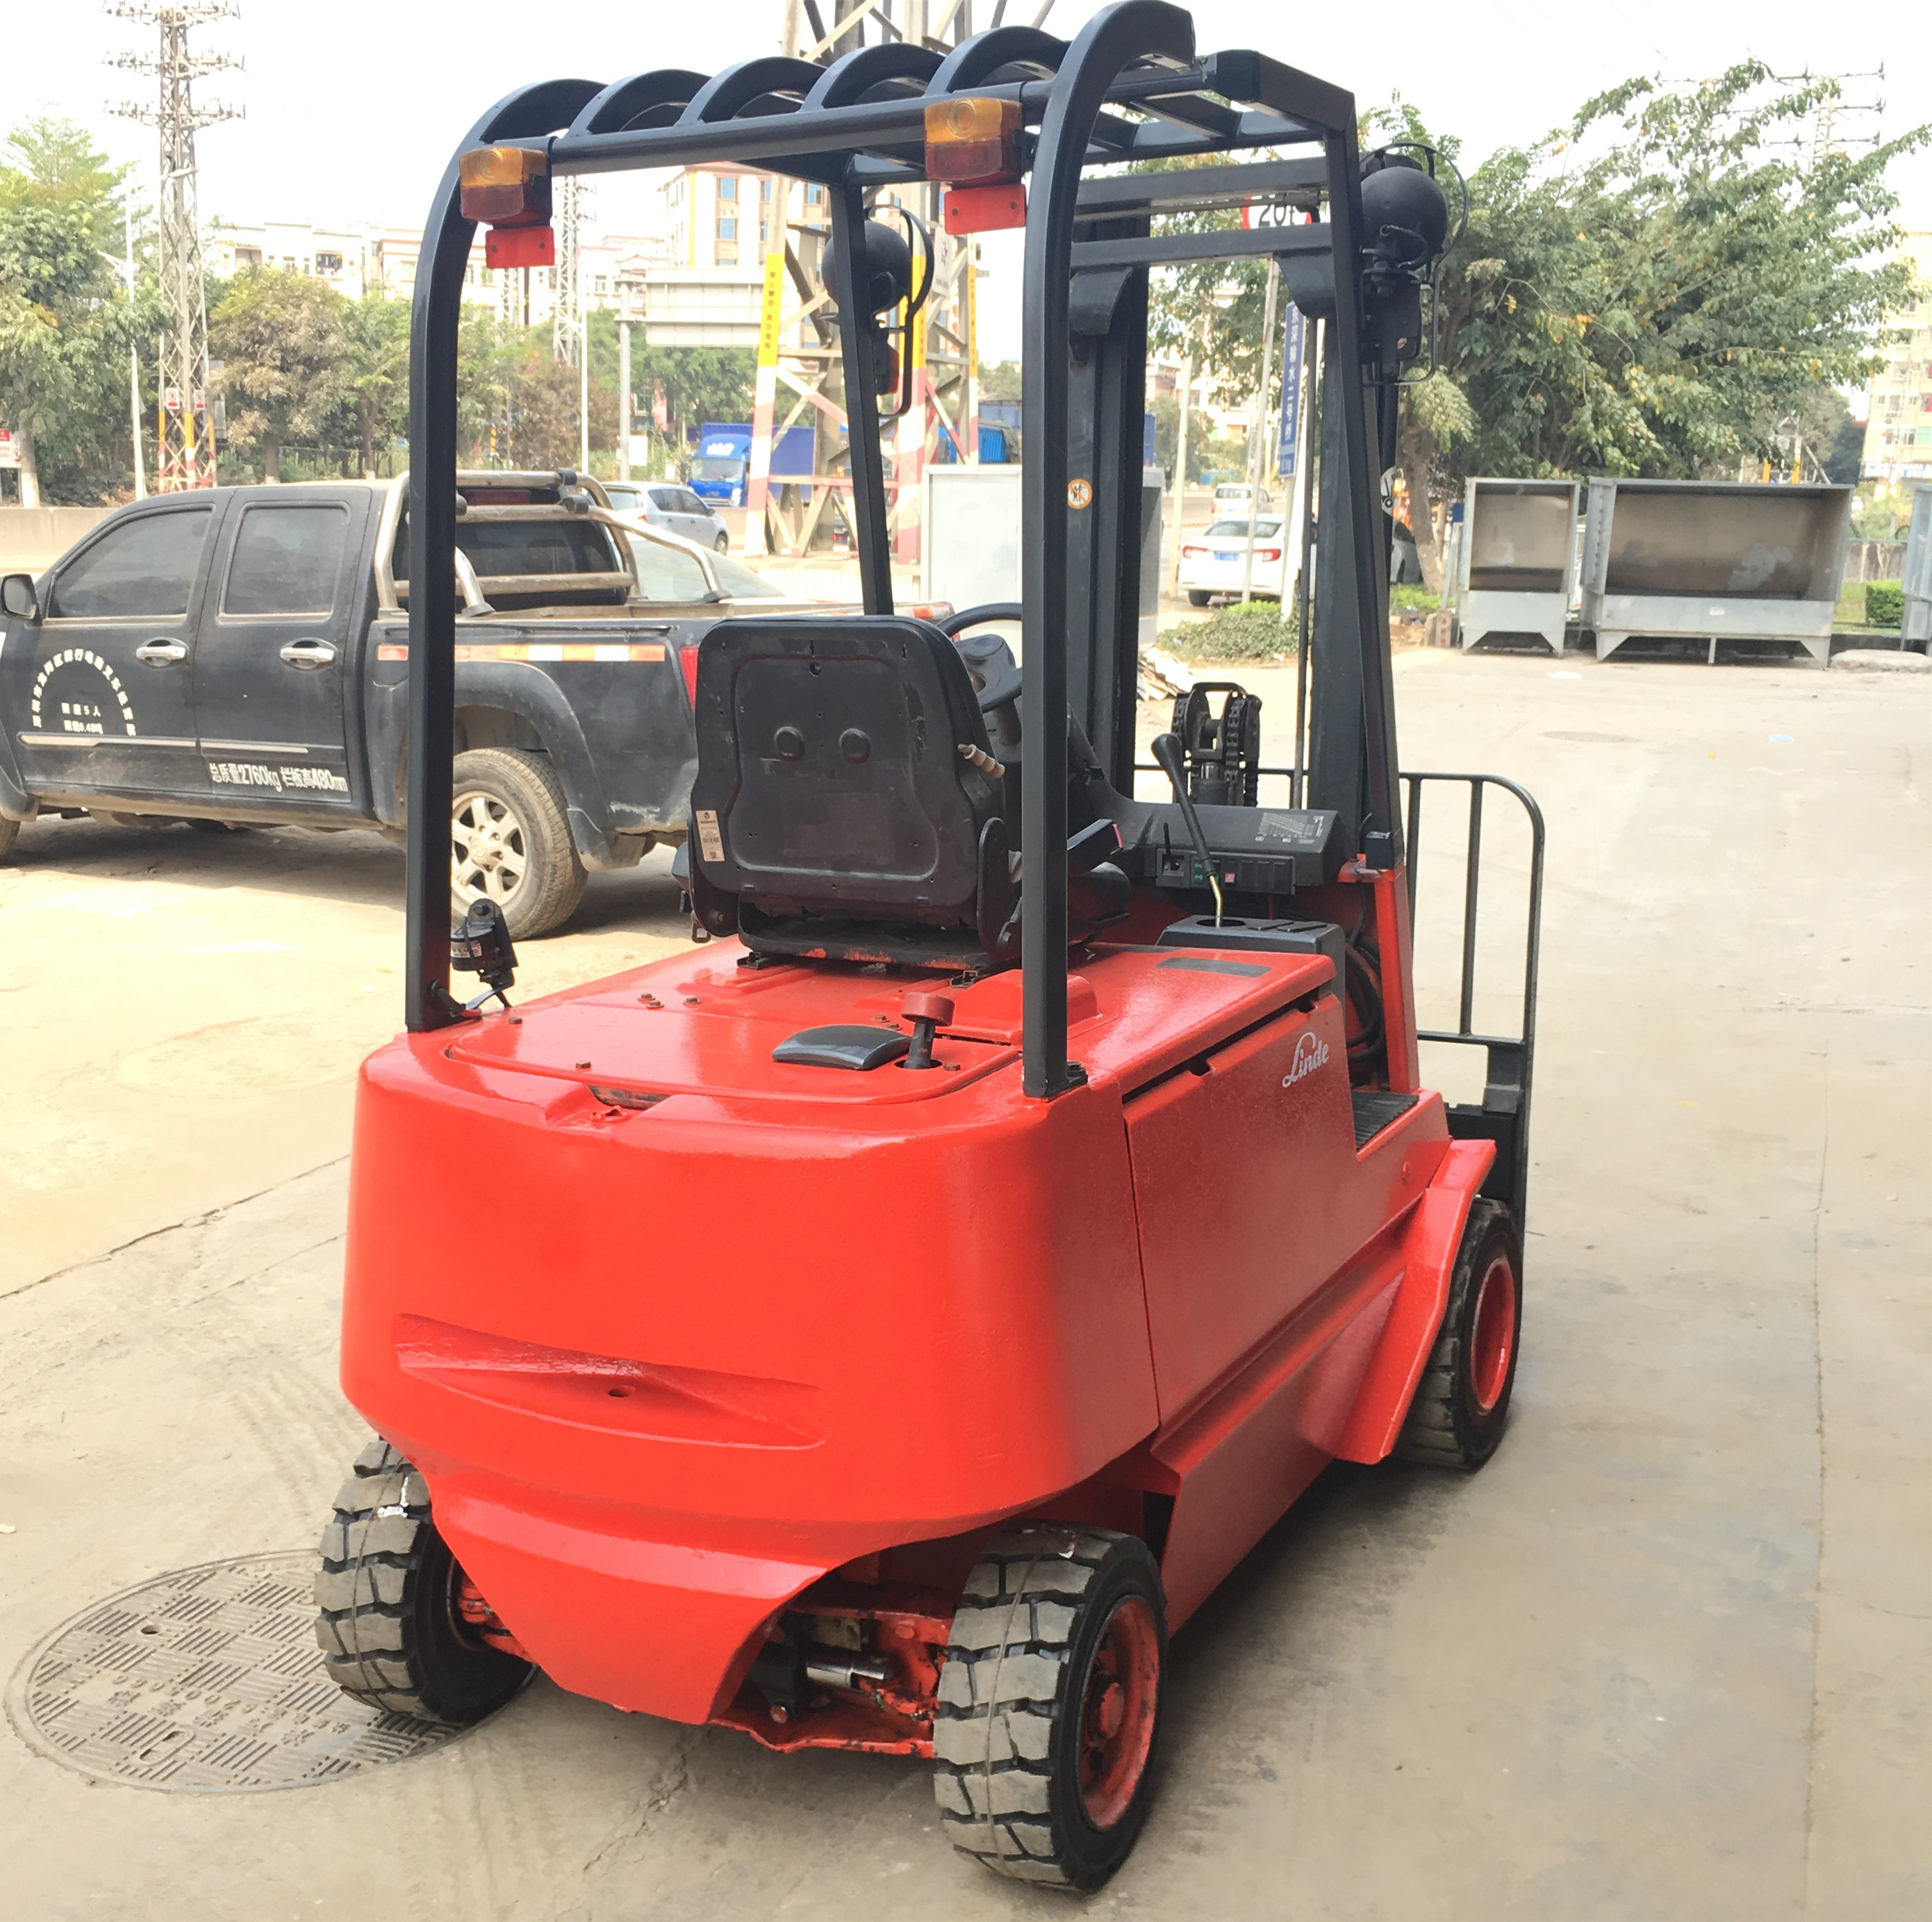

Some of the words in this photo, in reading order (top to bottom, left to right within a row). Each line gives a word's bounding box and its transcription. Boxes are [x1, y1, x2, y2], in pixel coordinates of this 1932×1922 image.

[209, 763, 282, 792] 总质量2760kg
[280, 766, 349, 792] 栏板高480mm
[1282, 1032, 1330, 1088] Linde
